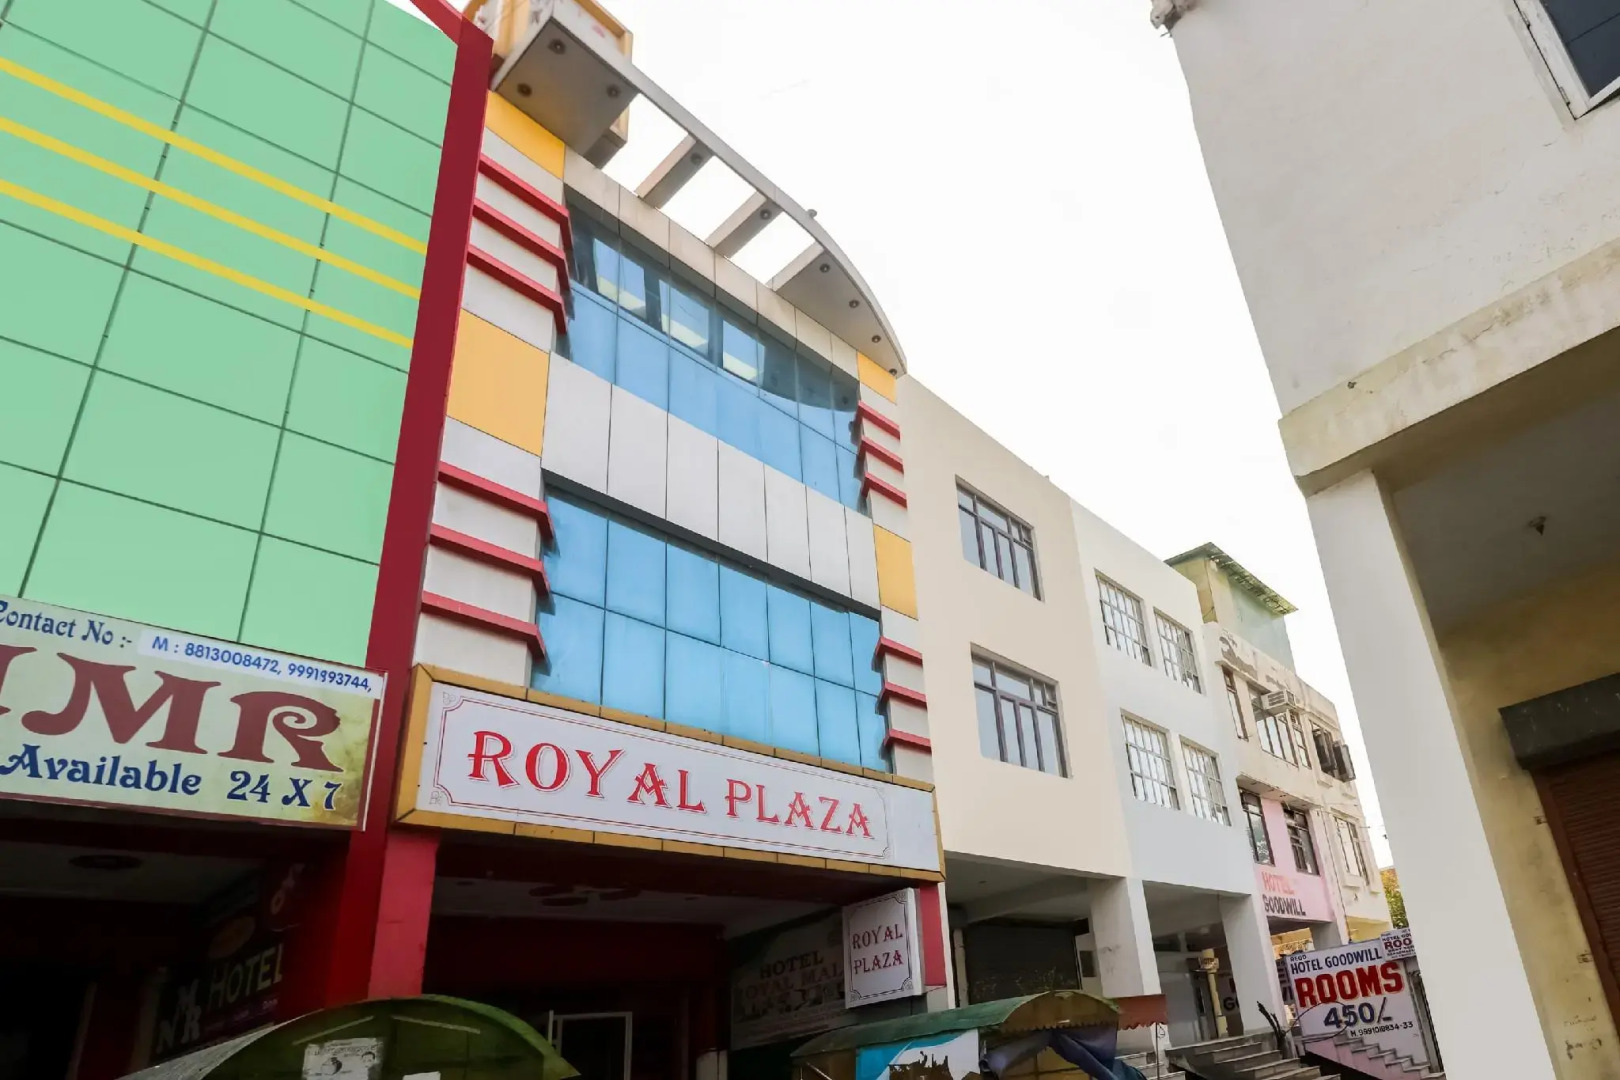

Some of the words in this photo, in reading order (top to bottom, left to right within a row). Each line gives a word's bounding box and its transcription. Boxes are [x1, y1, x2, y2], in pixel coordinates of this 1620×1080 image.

[81, 619, 114, 645] No
[184, 642, 282, 675] 8813008472,
[0, 743, 202, 796] Available
[226, 770, 271, 803] 24
[323, 780, 344, 812] 7
[467, 731, 707, 814] ROYAL
[724, 777, 875, 840] PLAZA
[1262, 893, 1306, 916] GOODWILL
[852, 922, 904, 950] ROYAL
[759, 949, 824, 979] HOTEL
[853, 949, 904, 975] PLAZA
[1290, 958, 1323, 975] HOTEL
[1324, 947, 1383, 969] GOODWILL
[1293, 961, 1404, 1009] ROOMS
[1323, 997, 1392, 1029] 450/-
